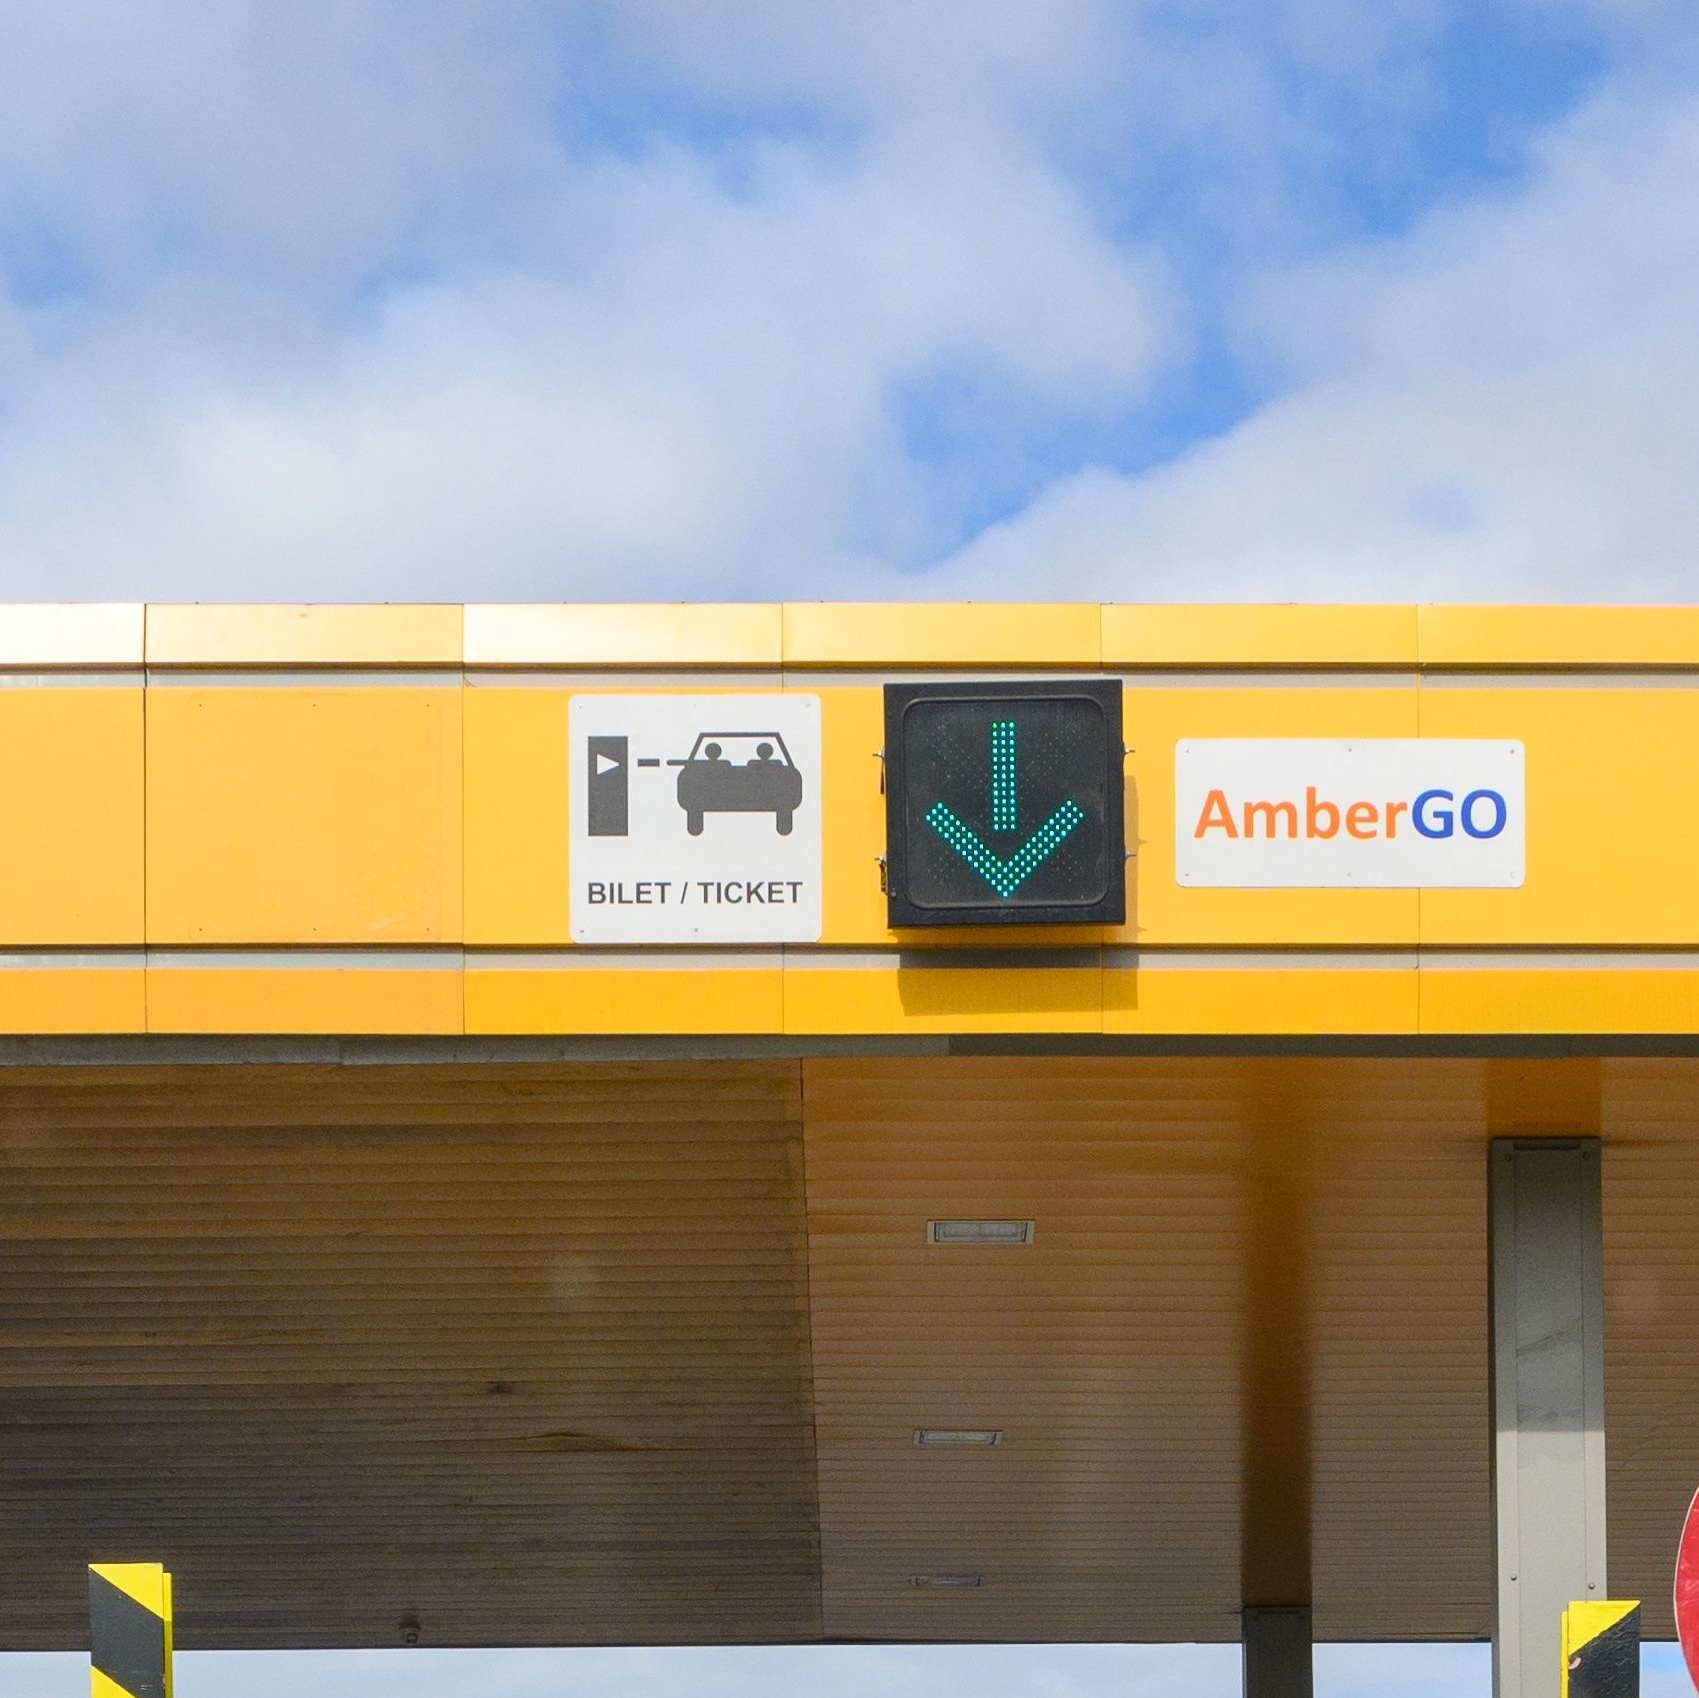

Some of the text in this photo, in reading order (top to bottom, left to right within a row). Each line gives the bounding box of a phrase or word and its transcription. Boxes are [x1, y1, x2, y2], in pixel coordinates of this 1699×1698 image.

[1193, 785, 1507, 842] AmberGO
[588, 882, 671, 904] BILET
[697, 882, 803, 904] TICKET
